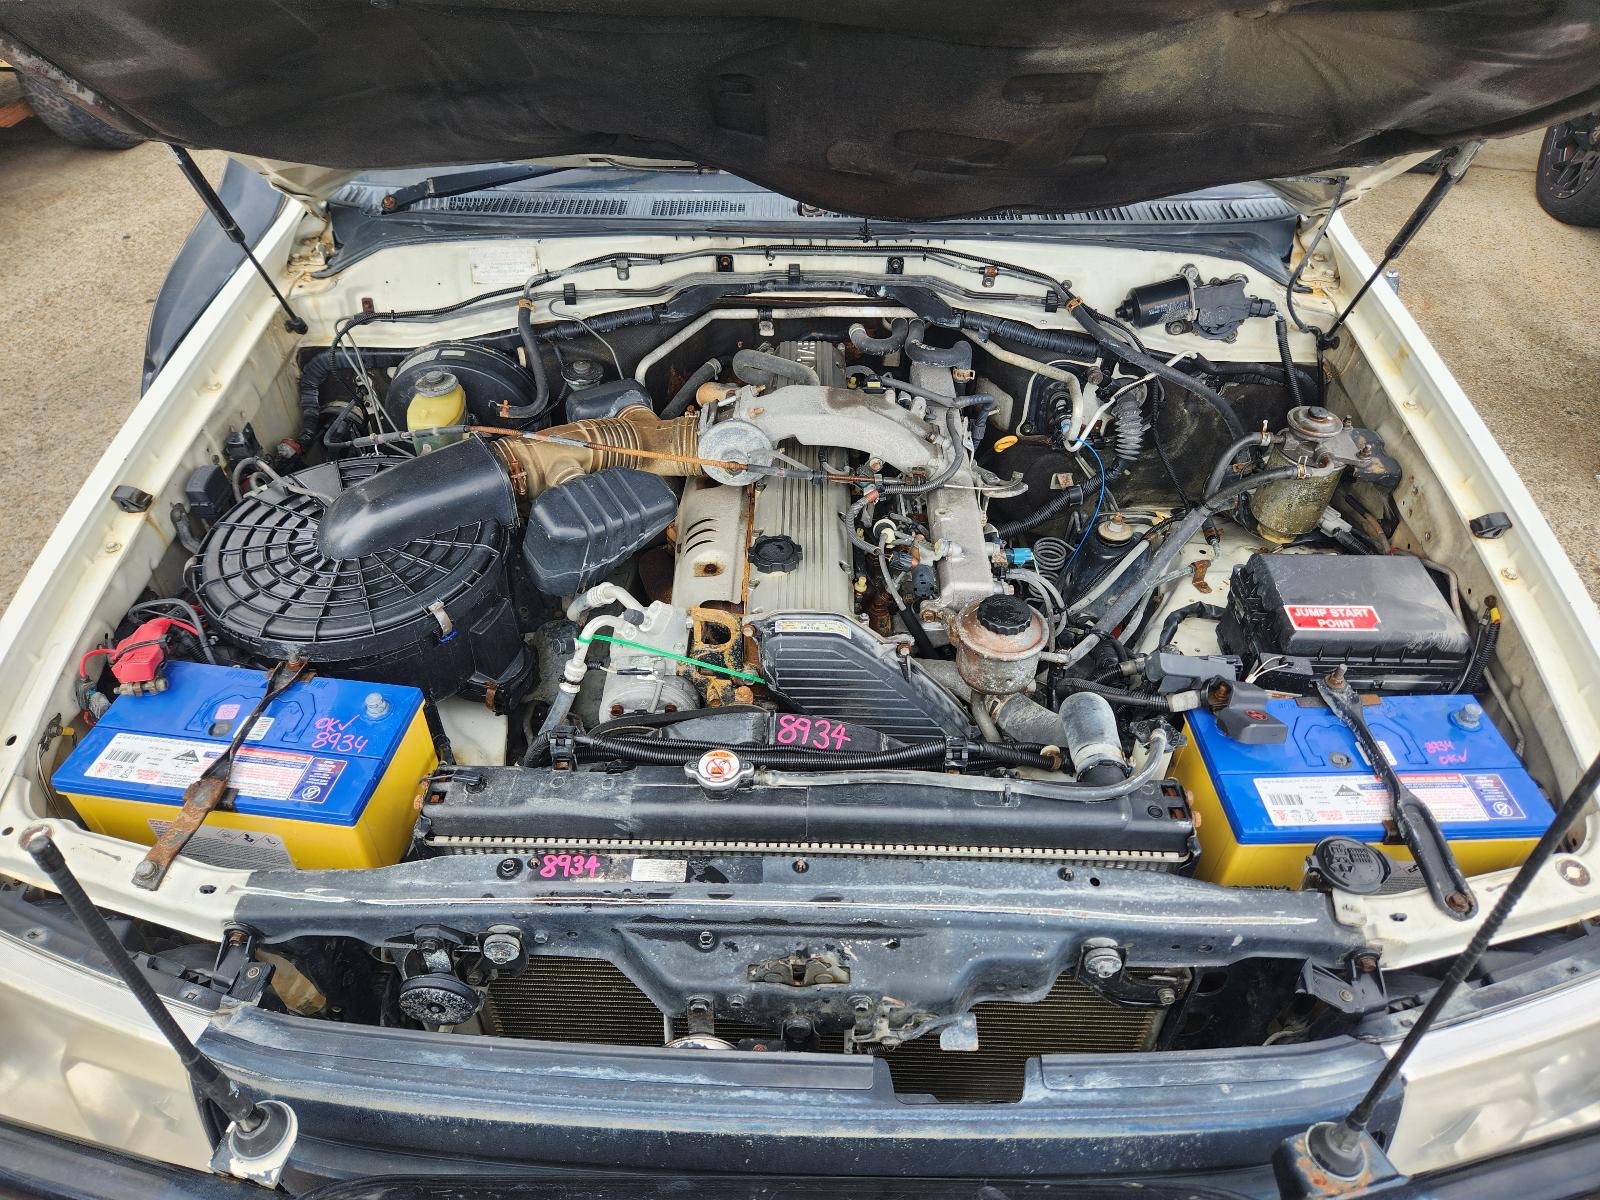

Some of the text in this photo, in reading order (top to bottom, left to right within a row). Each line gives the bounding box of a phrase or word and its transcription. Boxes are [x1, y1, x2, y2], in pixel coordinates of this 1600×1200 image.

[1294, 608, 1369, 617] JUMP START
[1317, 619, 1355, 628] POINT
[311, 732, 368, 753] 8934
[777, 714, 851, 750] 8934
[540, 855, 600, 878] 8934
